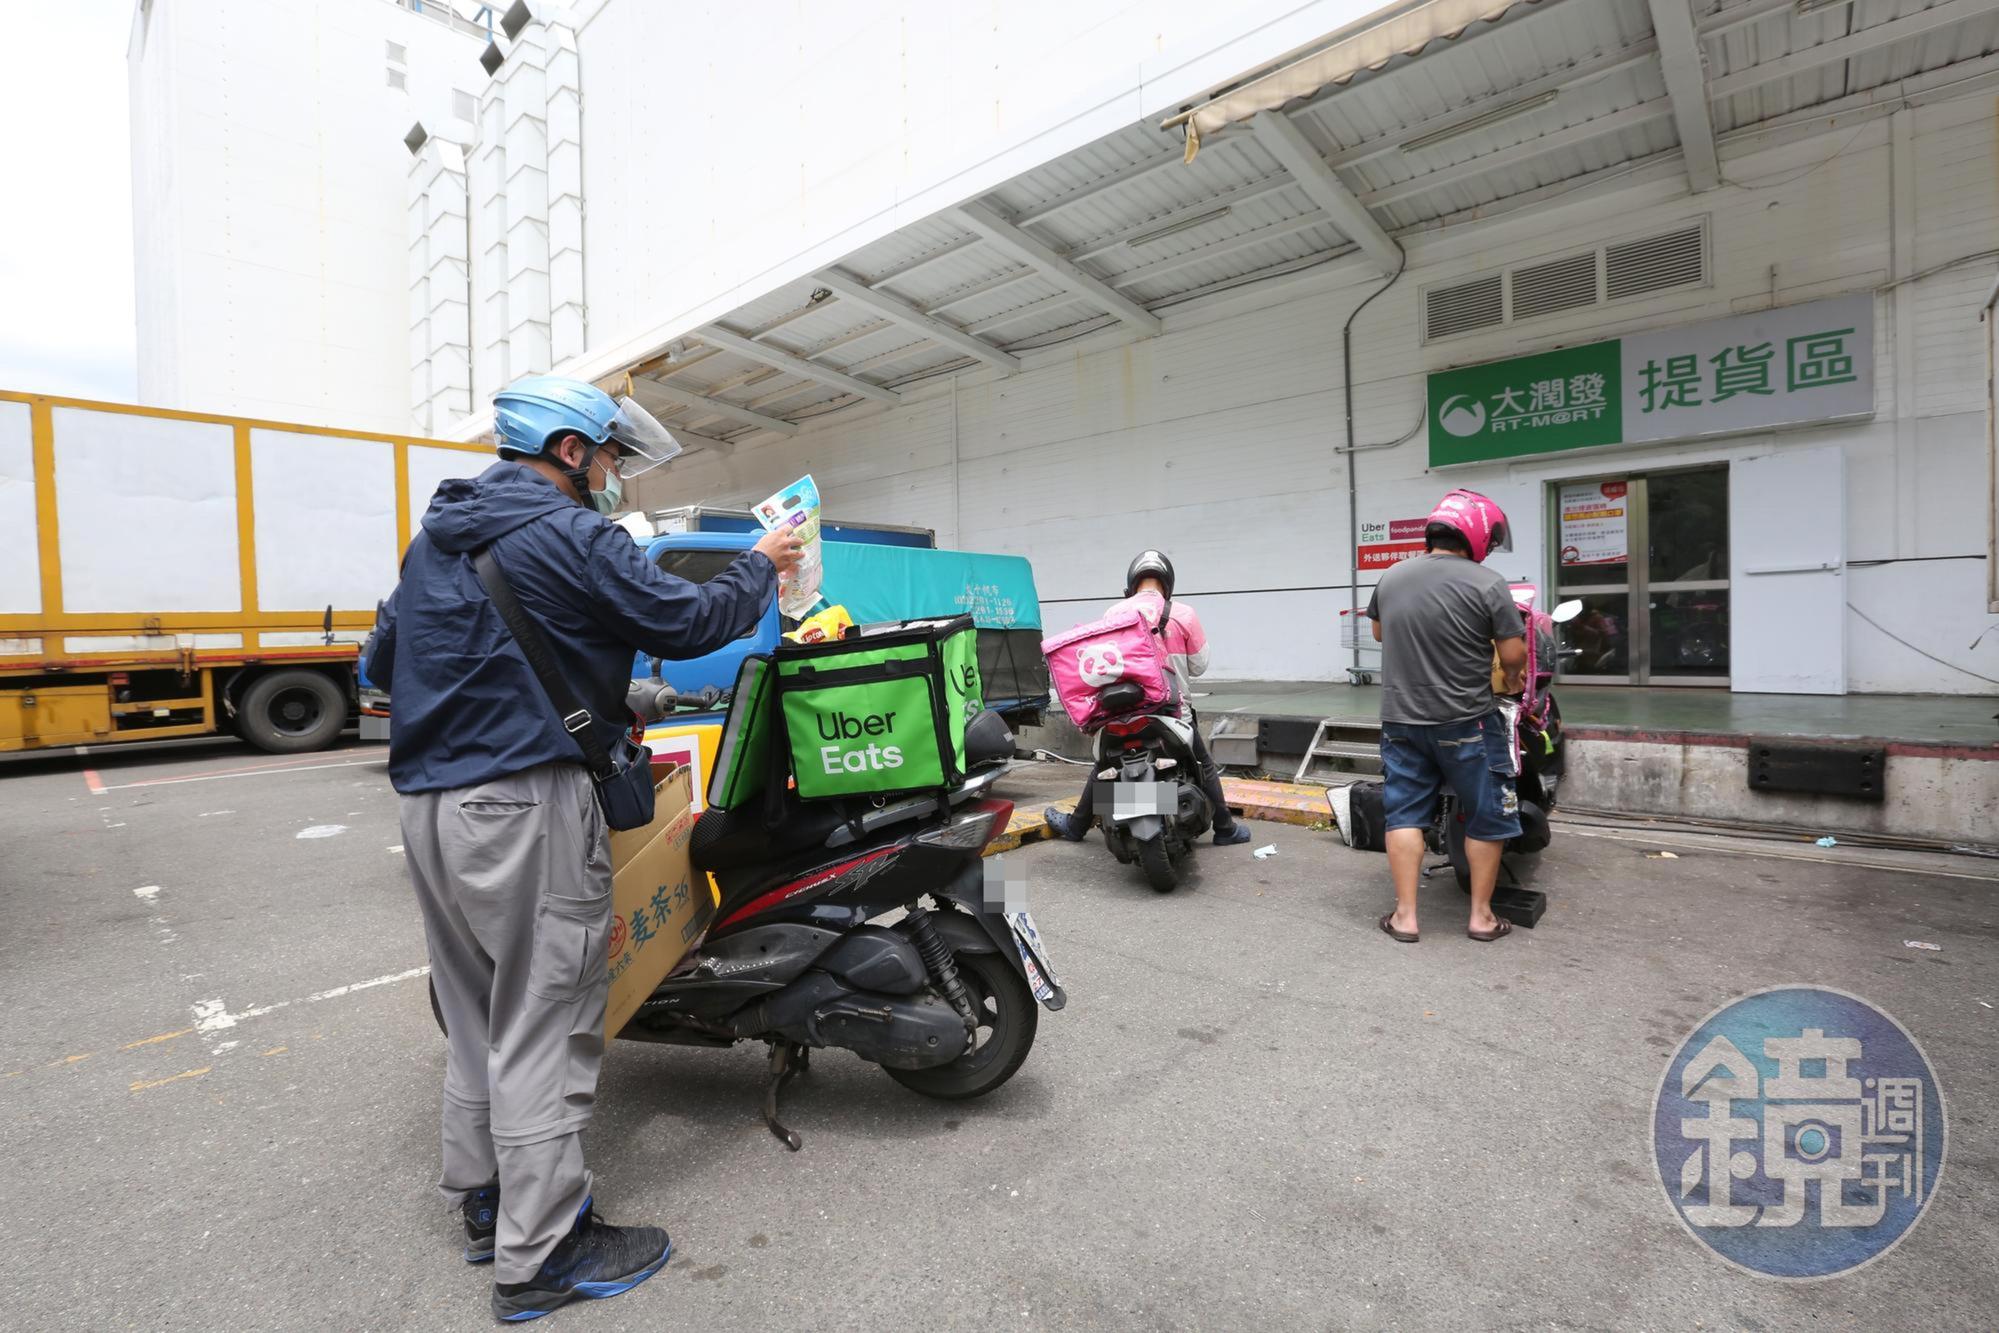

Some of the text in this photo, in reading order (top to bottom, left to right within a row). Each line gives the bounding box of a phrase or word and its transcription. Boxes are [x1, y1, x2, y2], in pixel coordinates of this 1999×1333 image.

[1638, 328, 1857, 413] 提貨區
[1491, 372, 1606, 417] 大潤發
[1491, 406, 1606, 433] RT-M@RT
[1361, 523, 1385, 532] Uber
[1362, 533, 1385, 542] Eats
[816, 711, 897, 741] Uber
[820, 743, 904, 775] Eats
